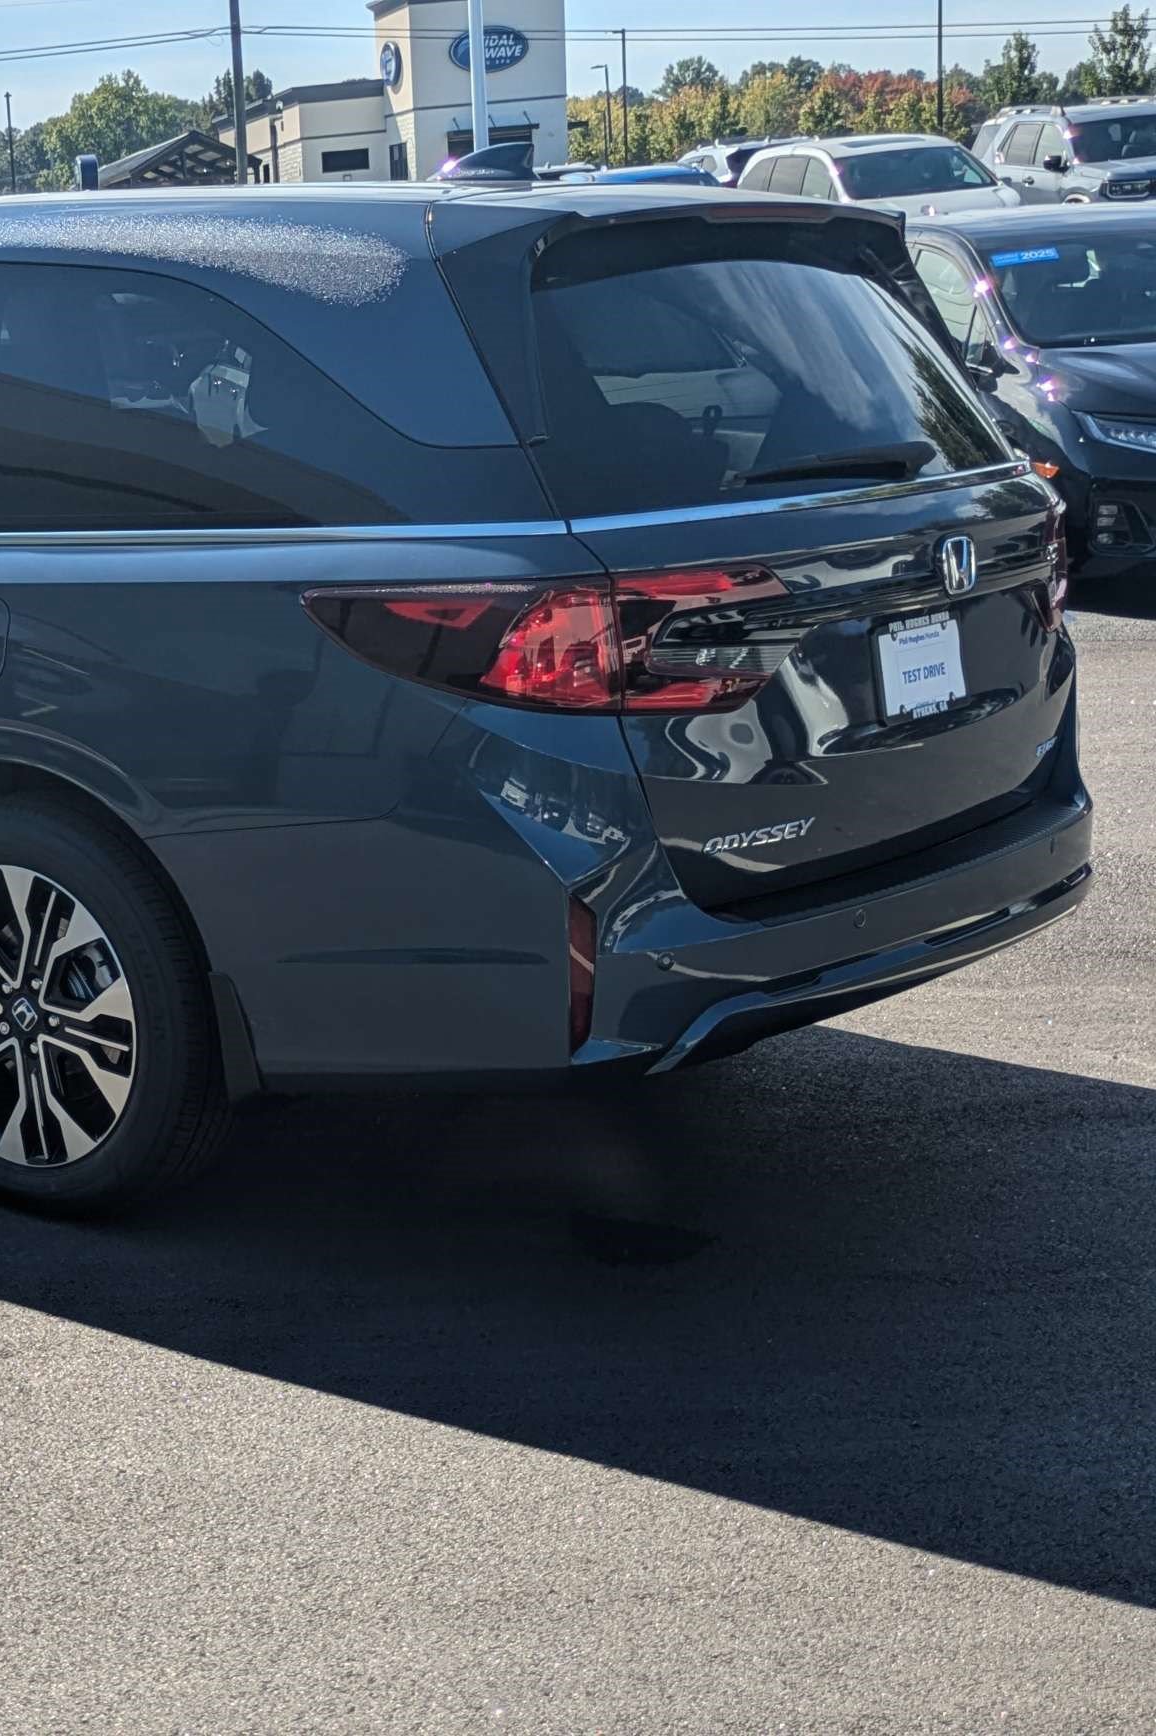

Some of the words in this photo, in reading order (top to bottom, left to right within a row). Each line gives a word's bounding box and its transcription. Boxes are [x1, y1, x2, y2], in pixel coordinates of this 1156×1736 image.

[485, 45, 522, 58] WAVE
[1020, 248, 1054, 259] 2025
[902, 668, 921, 684] TEST
[923, 662, 945, 679] DRIVE
[703, 816, 816, 855] ODYSSEY
